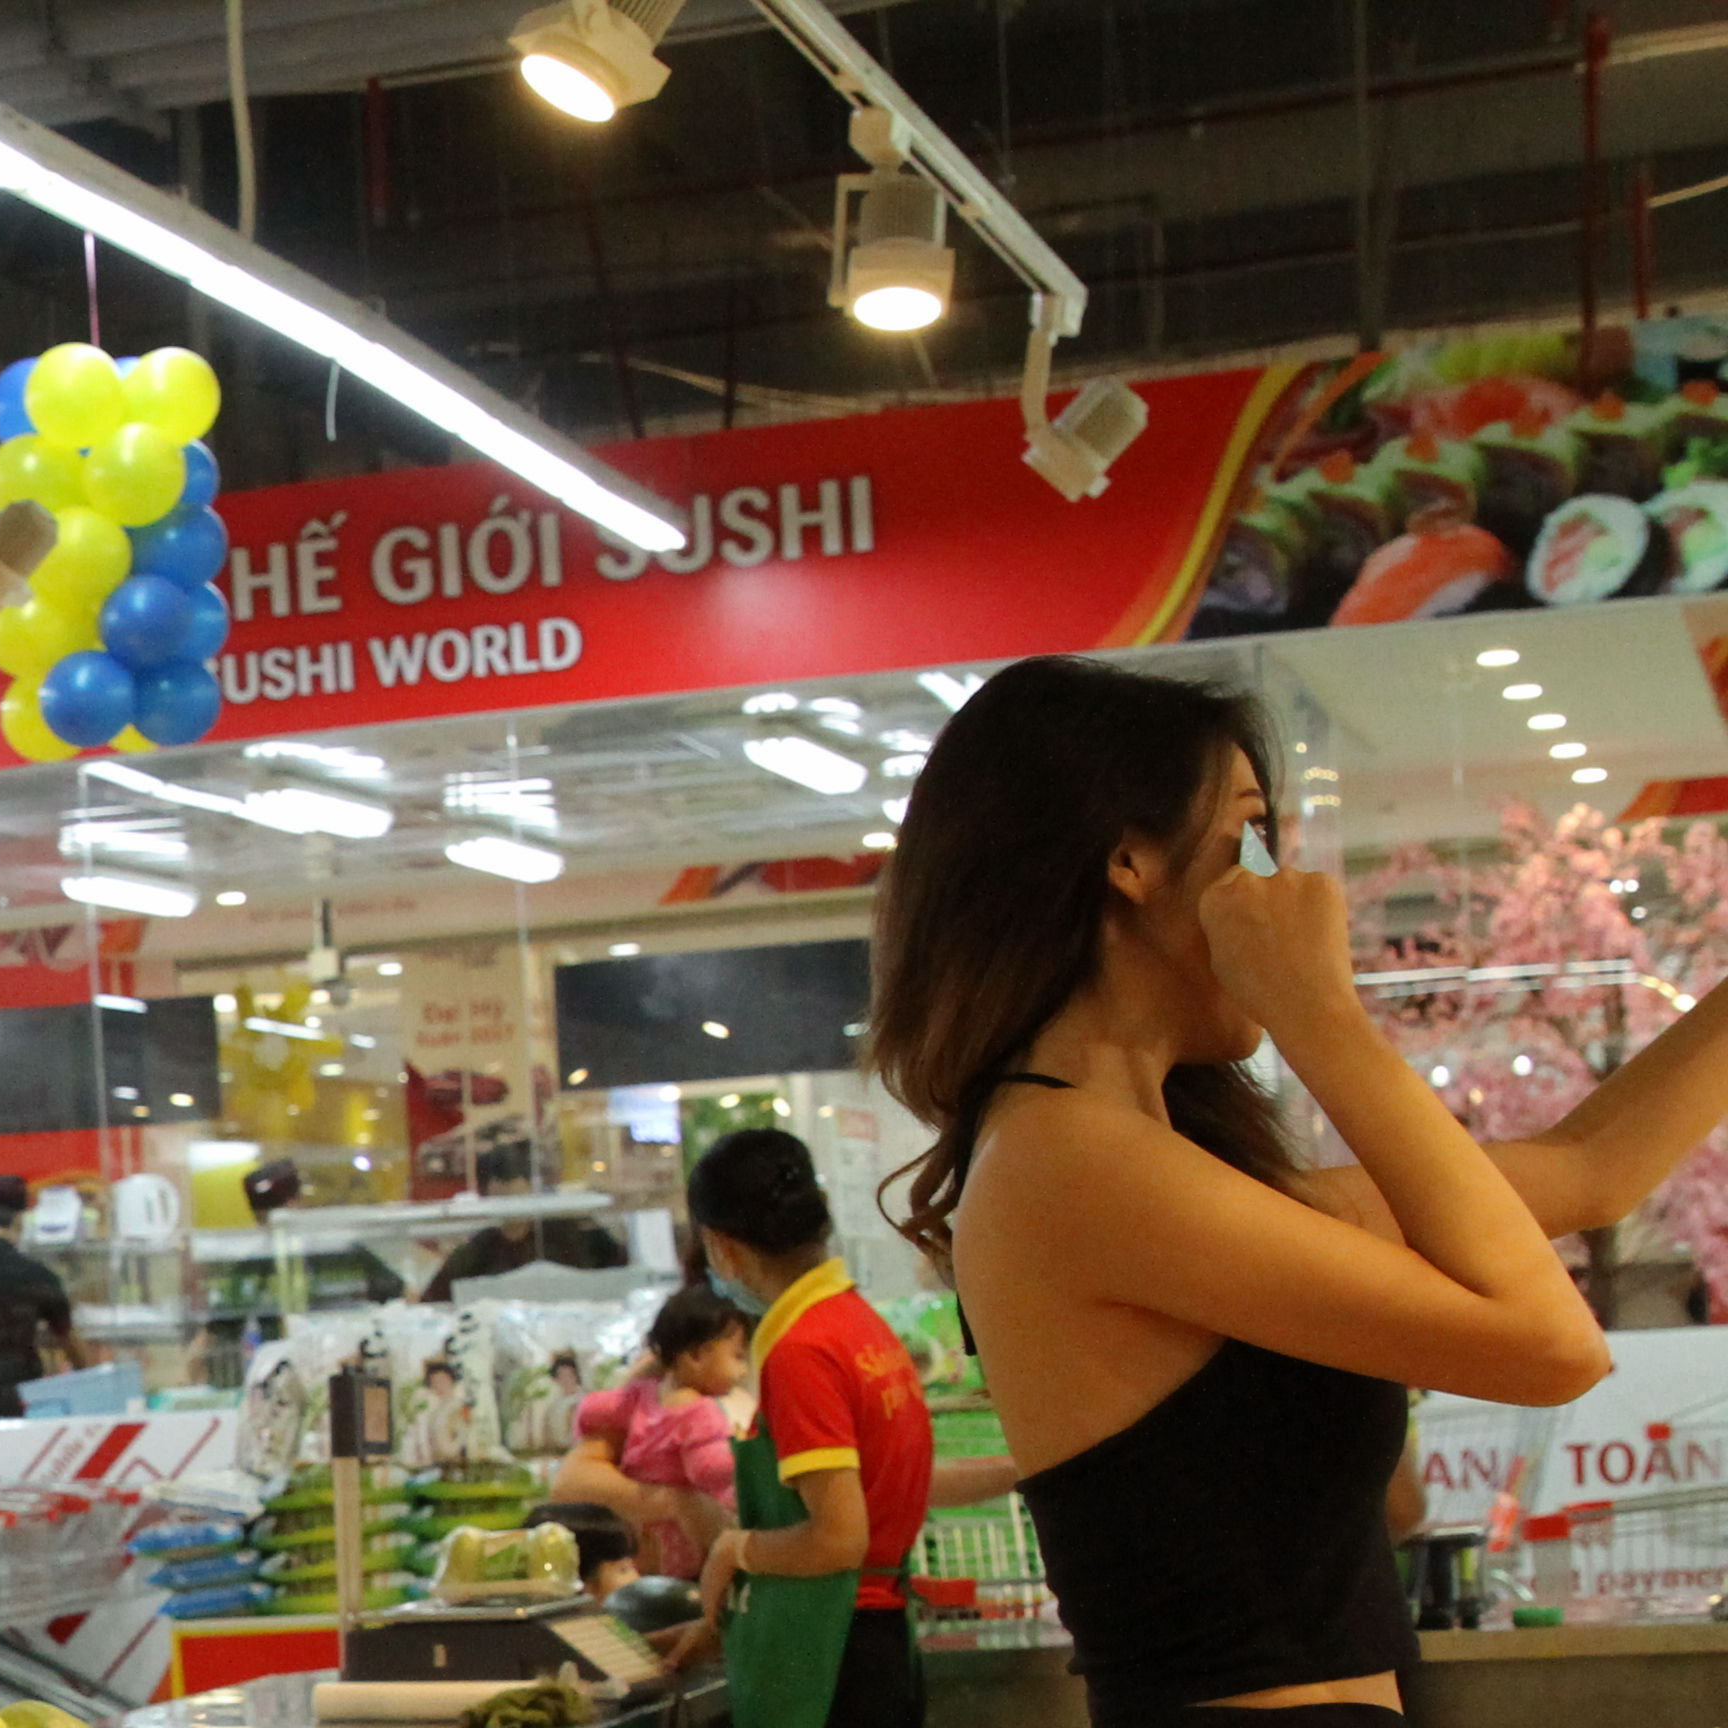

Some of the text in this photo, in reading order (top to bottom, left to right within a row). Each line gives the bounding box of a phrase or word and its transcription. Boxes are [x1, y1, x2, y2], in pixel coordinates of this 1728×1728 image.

[230, 510, 348, 621] HẾ
[371, 495, 563, 605] GIỚI
[206, 617, 583, 704] USHI WORLD
